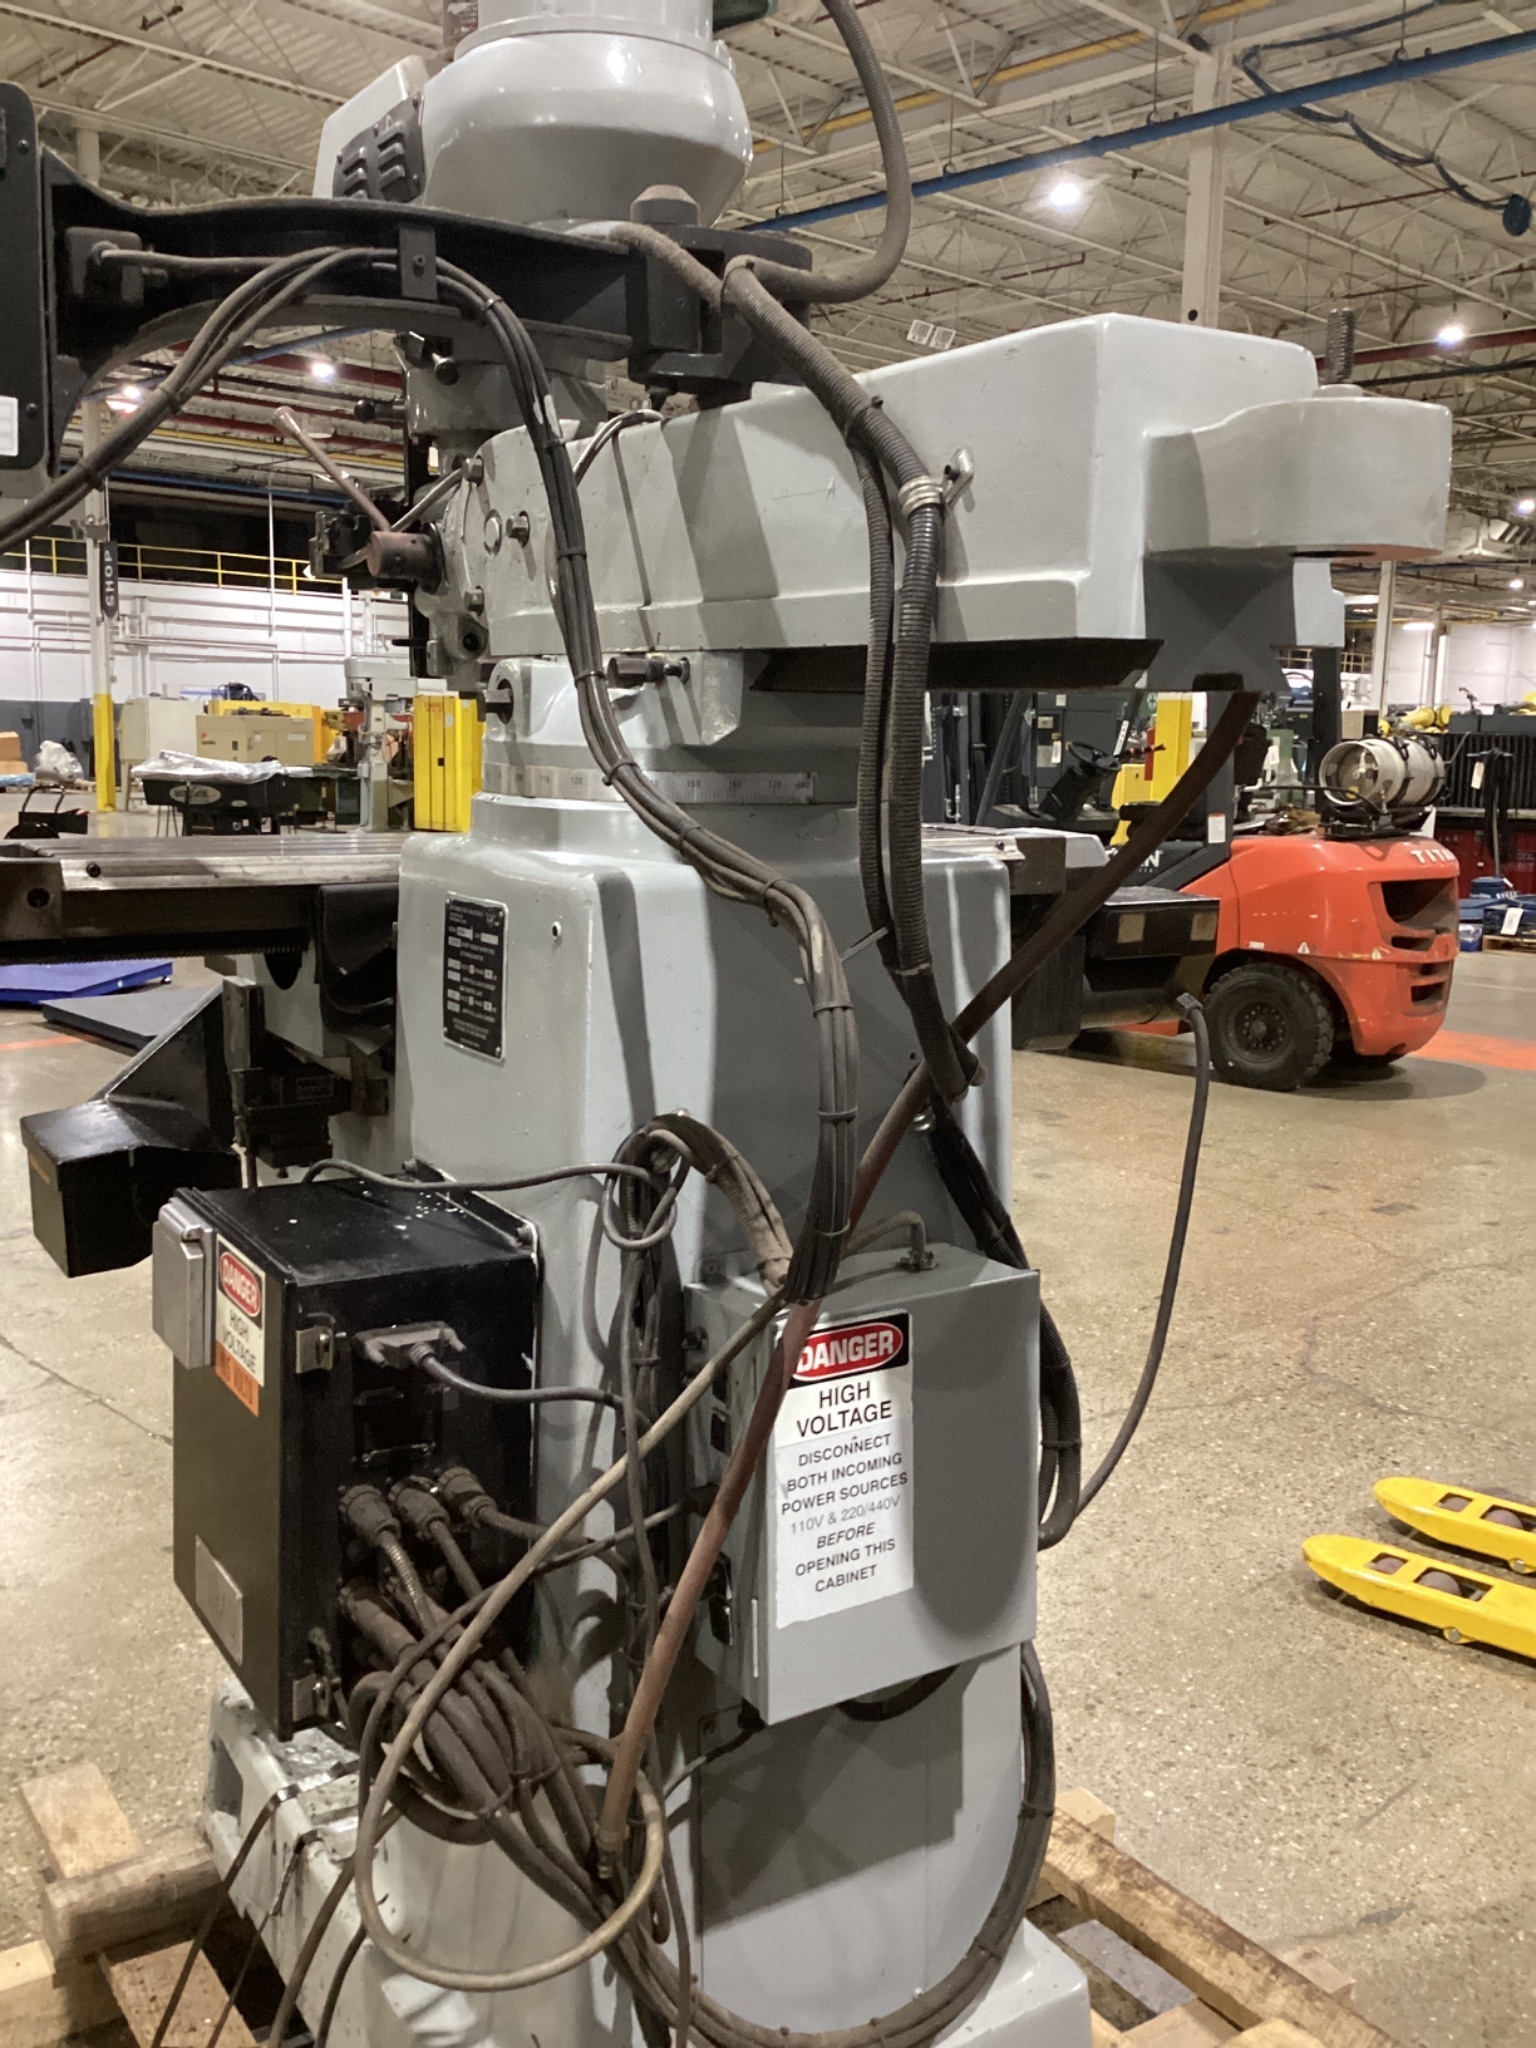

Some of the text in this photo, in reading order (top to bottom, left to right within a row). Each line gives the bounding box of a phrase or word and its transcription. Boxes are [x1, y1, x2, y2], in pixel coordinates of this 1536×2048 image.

[104, 550, 114, 606] SHOP
[687, 779, 701, 788] 150
[222, 1258, 257, 1311] DANGER
[230, 1308, 249, 1342] HIGH
[223, 1325, 256, 1374] VOLTAGE
[796, 1330, 894, 1373] DANGER
[819, 1381, 870, 1409] HIGH
[796, 1400, 892, 1437] VOLTAGE
[798, 1433, 891, 1467] DISCONNECT
[787, 1452, 902, 1492] BOTH INCOMING
[782, 1472, 908, 1515] POWER SOURCES
[791, 1494, 901, 1535] 110V & 220/440V
[816, 1522, 876, 1549] BEFORE
[795, 1538, 896, 1577] OPENING THIS
[815, 1564, 878, 1592] CABINET
